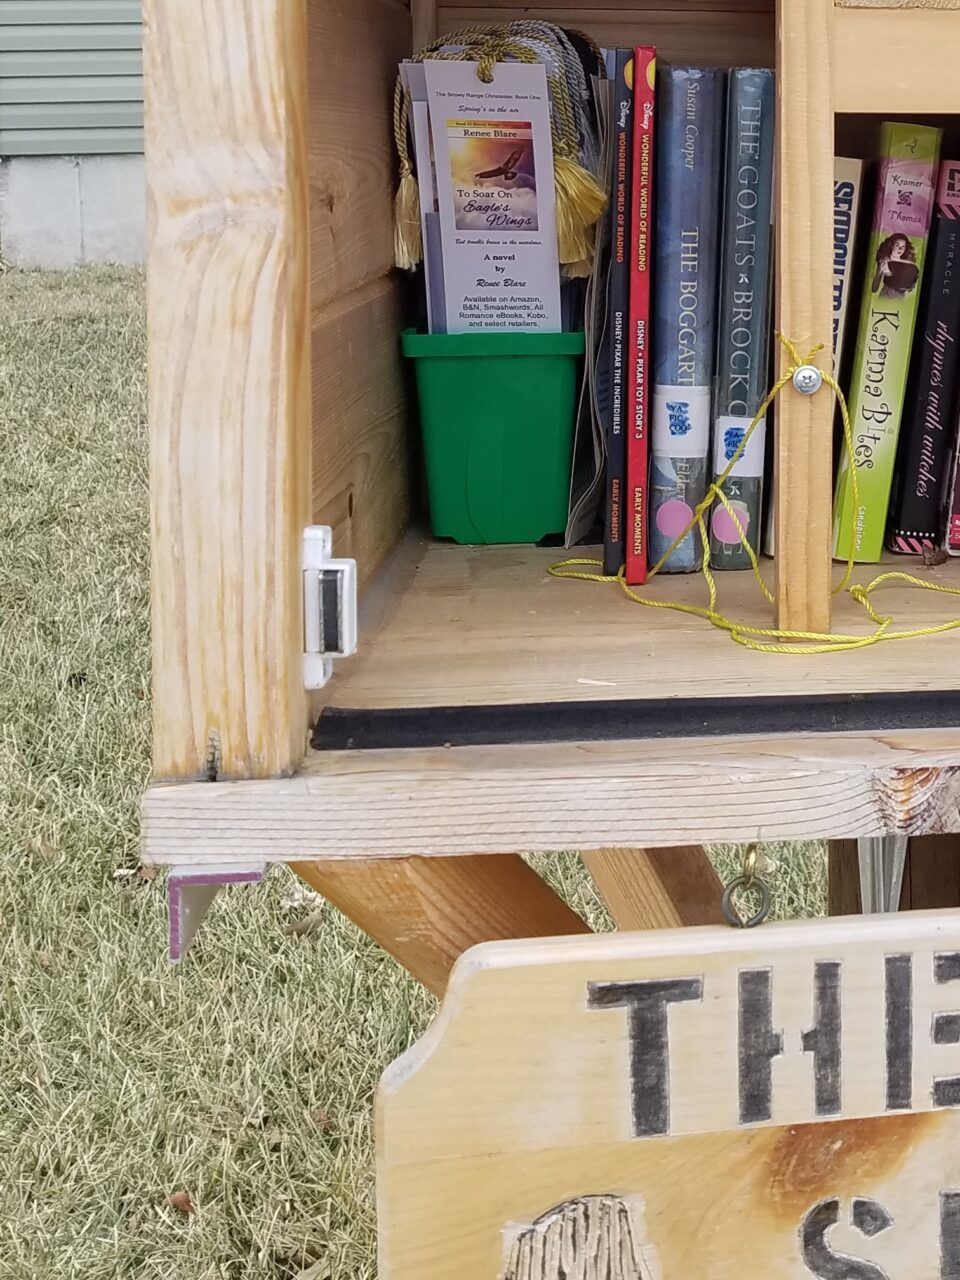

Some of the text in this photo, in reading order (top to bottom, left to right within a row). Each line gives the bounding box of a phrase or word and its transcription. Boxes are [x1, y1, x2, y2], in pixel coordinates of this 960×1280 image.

[463, 129, 518, 138] Renee Blare
[681, 81, 701, 171] Susan Cooper
[739, 100, 762, 156] THE
[457, 189, 513, 199] To Soar On
[463, 200, 511, 215] Eagle's
[616, 131, 627, 263] WONDERFUL WORLD READING
[638, 99, 654, 271] Disney WONDERFUL WORLD READING
[891, 174, 924, 188] Kramer
[486, 213, 533, 228] Wings
[734, 165, 759, 266] GOATS
[476, 278, 501, 288] Renee
[495, 265, 505, 274] by
[942, 233, 957, 296] MYRACLE
[677, 226, 700, 385] THE BOGGART
[730, 290, 754, 391] BROCK
[635, 320, 645, 431] DISNEY PIXAR TOY STORY
[855, 309, 900, 469] Karma Bites
[613, 386, 621, 435] INCREDIBLES
[915, 320, 955, 498] rhymes with witches
[611, 479, 620, 543] EARLY MOMENTS
[634, 486, 642, 556] EARLY MOMENTS
